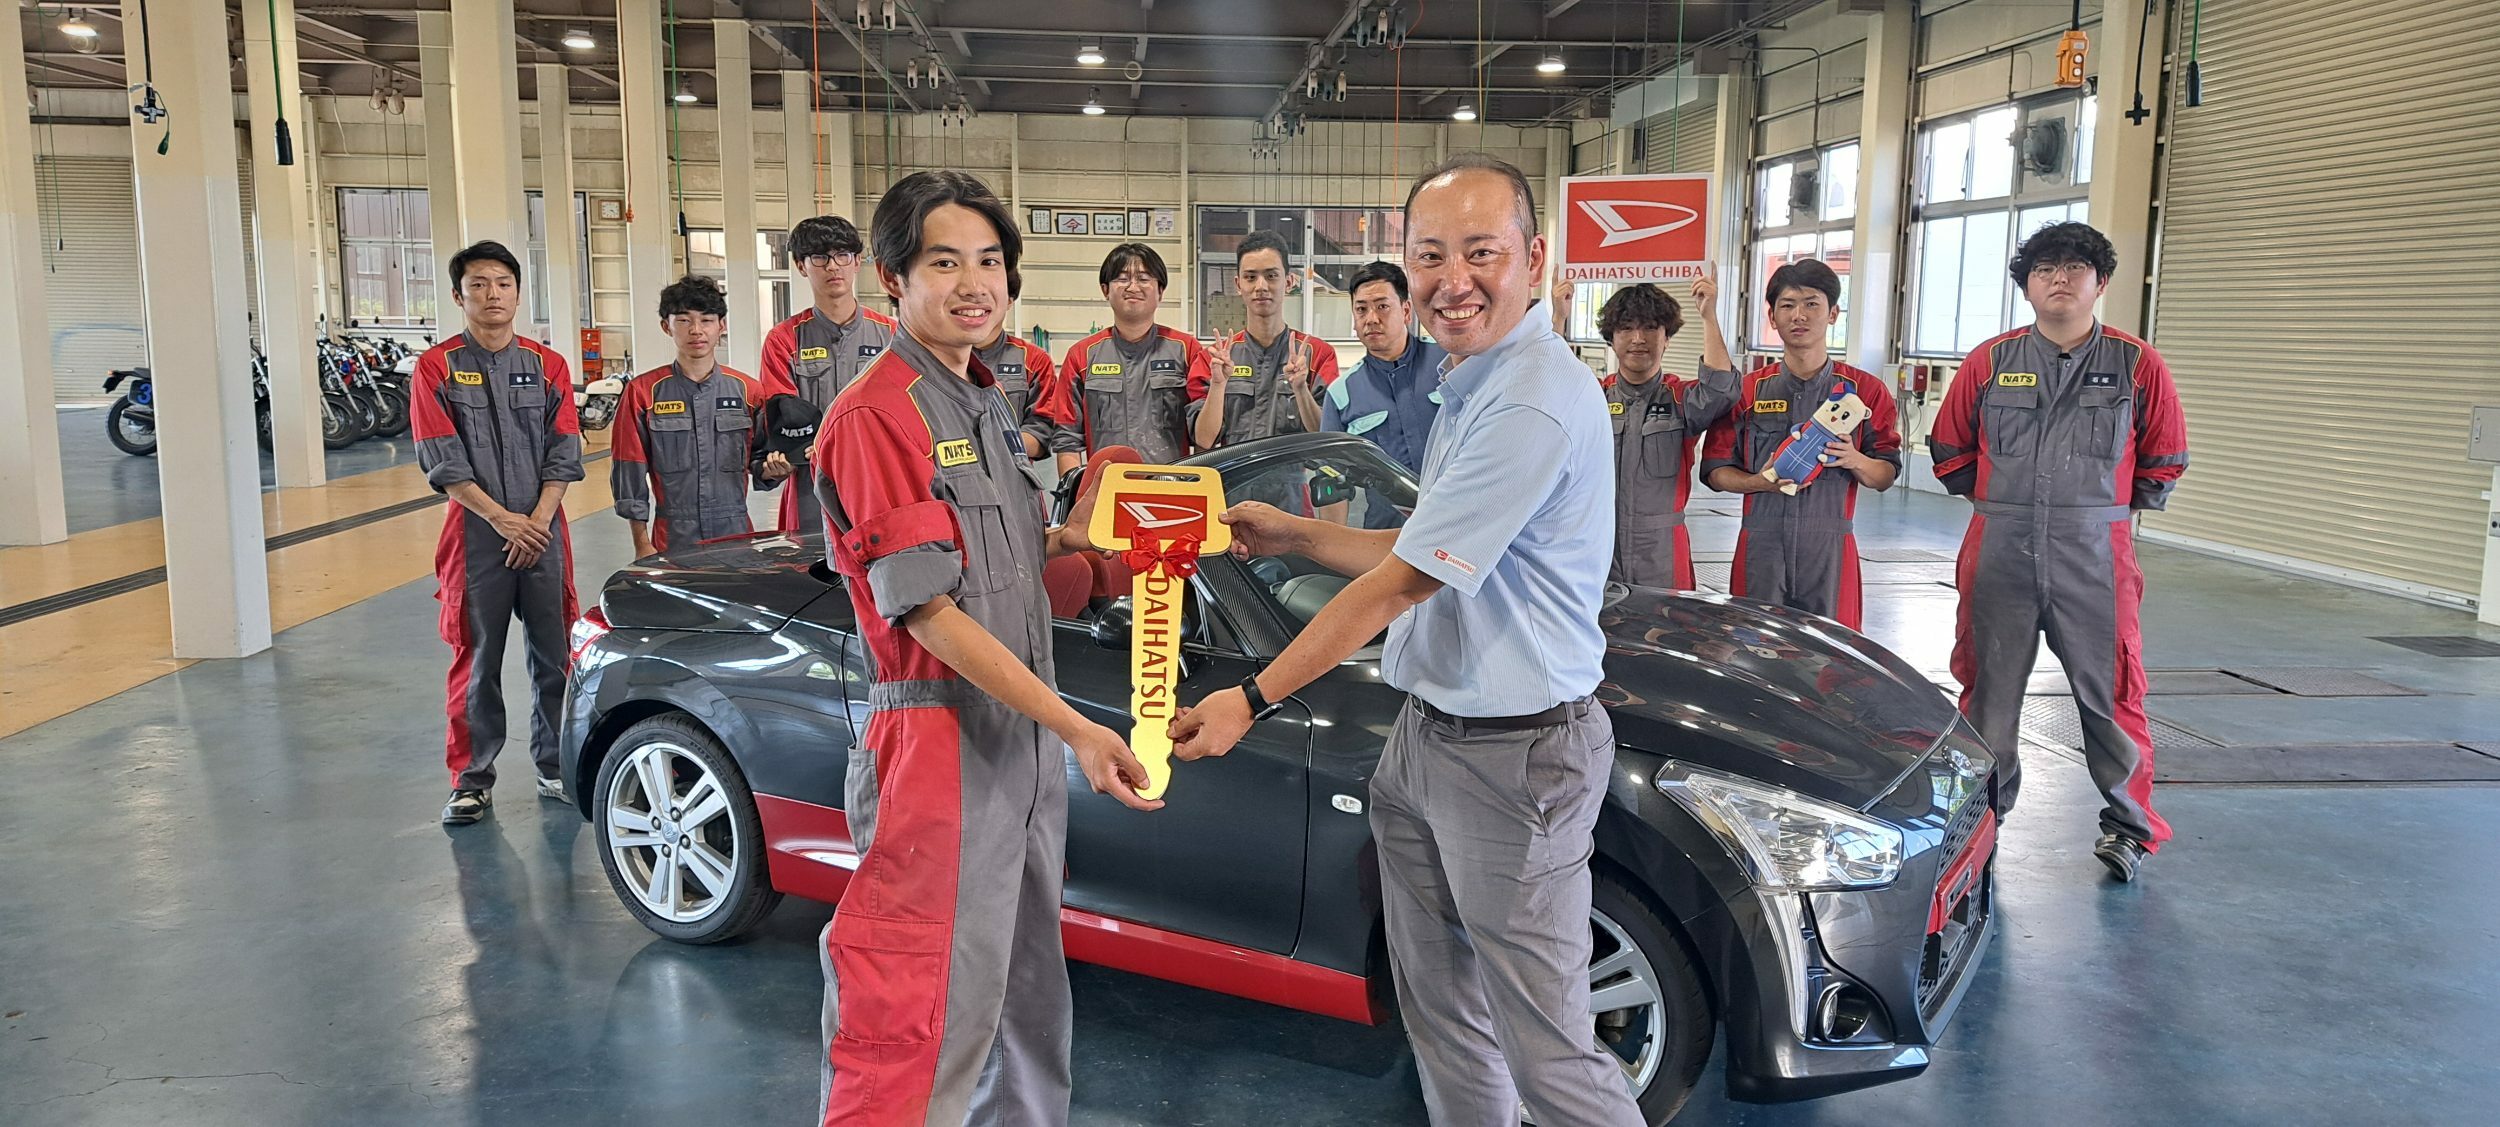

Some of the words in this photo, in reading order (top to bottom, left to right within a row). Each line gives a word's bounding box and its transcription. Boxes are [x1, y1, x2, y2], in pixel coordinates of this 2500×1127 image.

[1565, 266, 1646, 280] DAIHATSU
[1651, 265, 1704, 278] CHIBA
[802, 348, 825, 357] NATS
[457, 373, 480, 382] NATS
[2002, 375, 2034, 383] NATS
[656, 402, 682, 411] NATS
[1757, 401, 1785, 410] NATS
[780, 424, 814, 438] NATS
[943, 442, 974, 460] NATS
[1447, 556, 1474, 573] DAIHATSU
[1140, 574, 1171, 719] DAIHATSU
